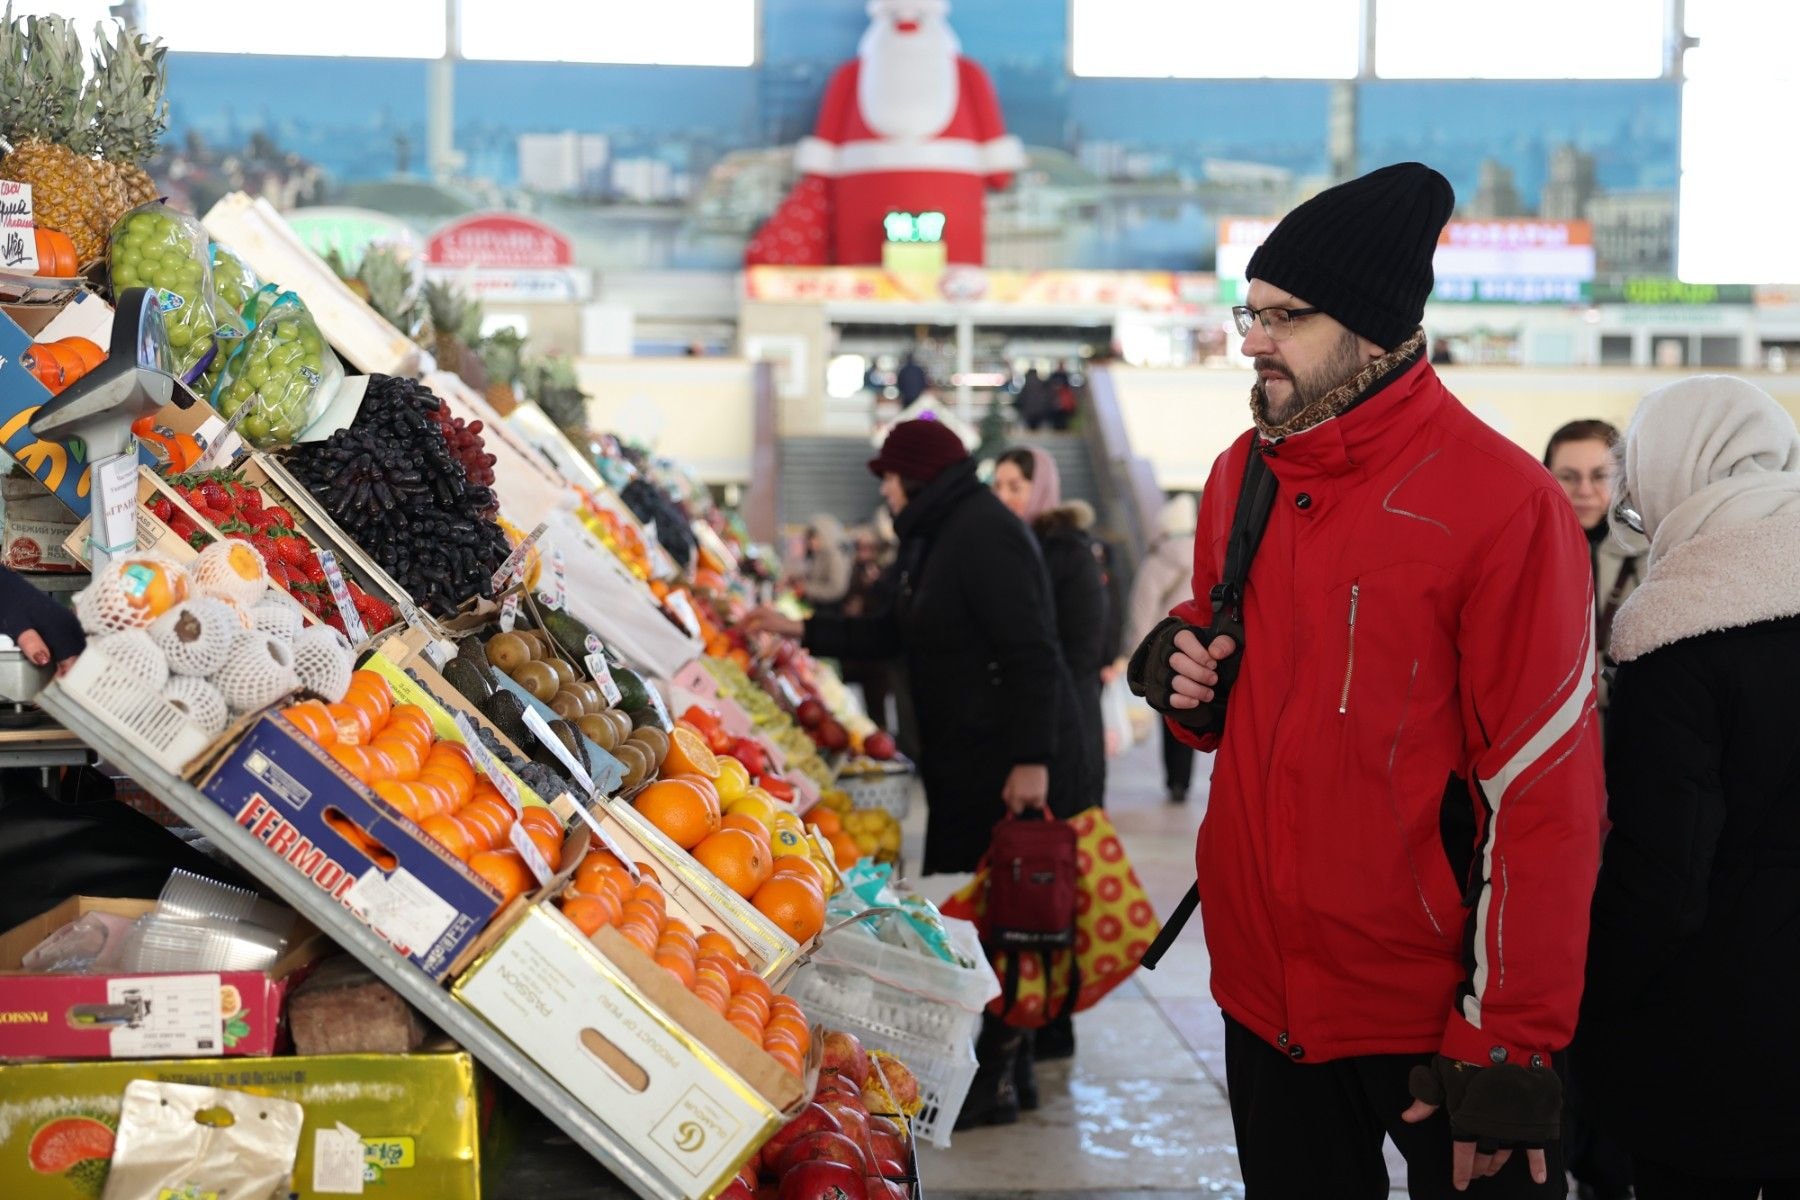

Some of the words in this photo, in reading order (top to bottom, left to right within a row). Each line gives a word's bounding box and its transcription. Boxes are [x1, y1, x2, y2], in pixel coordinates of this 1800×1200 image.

[50, 527, 73, 536] УРО
[498, 965, 552, 1017] PASSION
[0, 1011, 49, 1025] PASSIO
